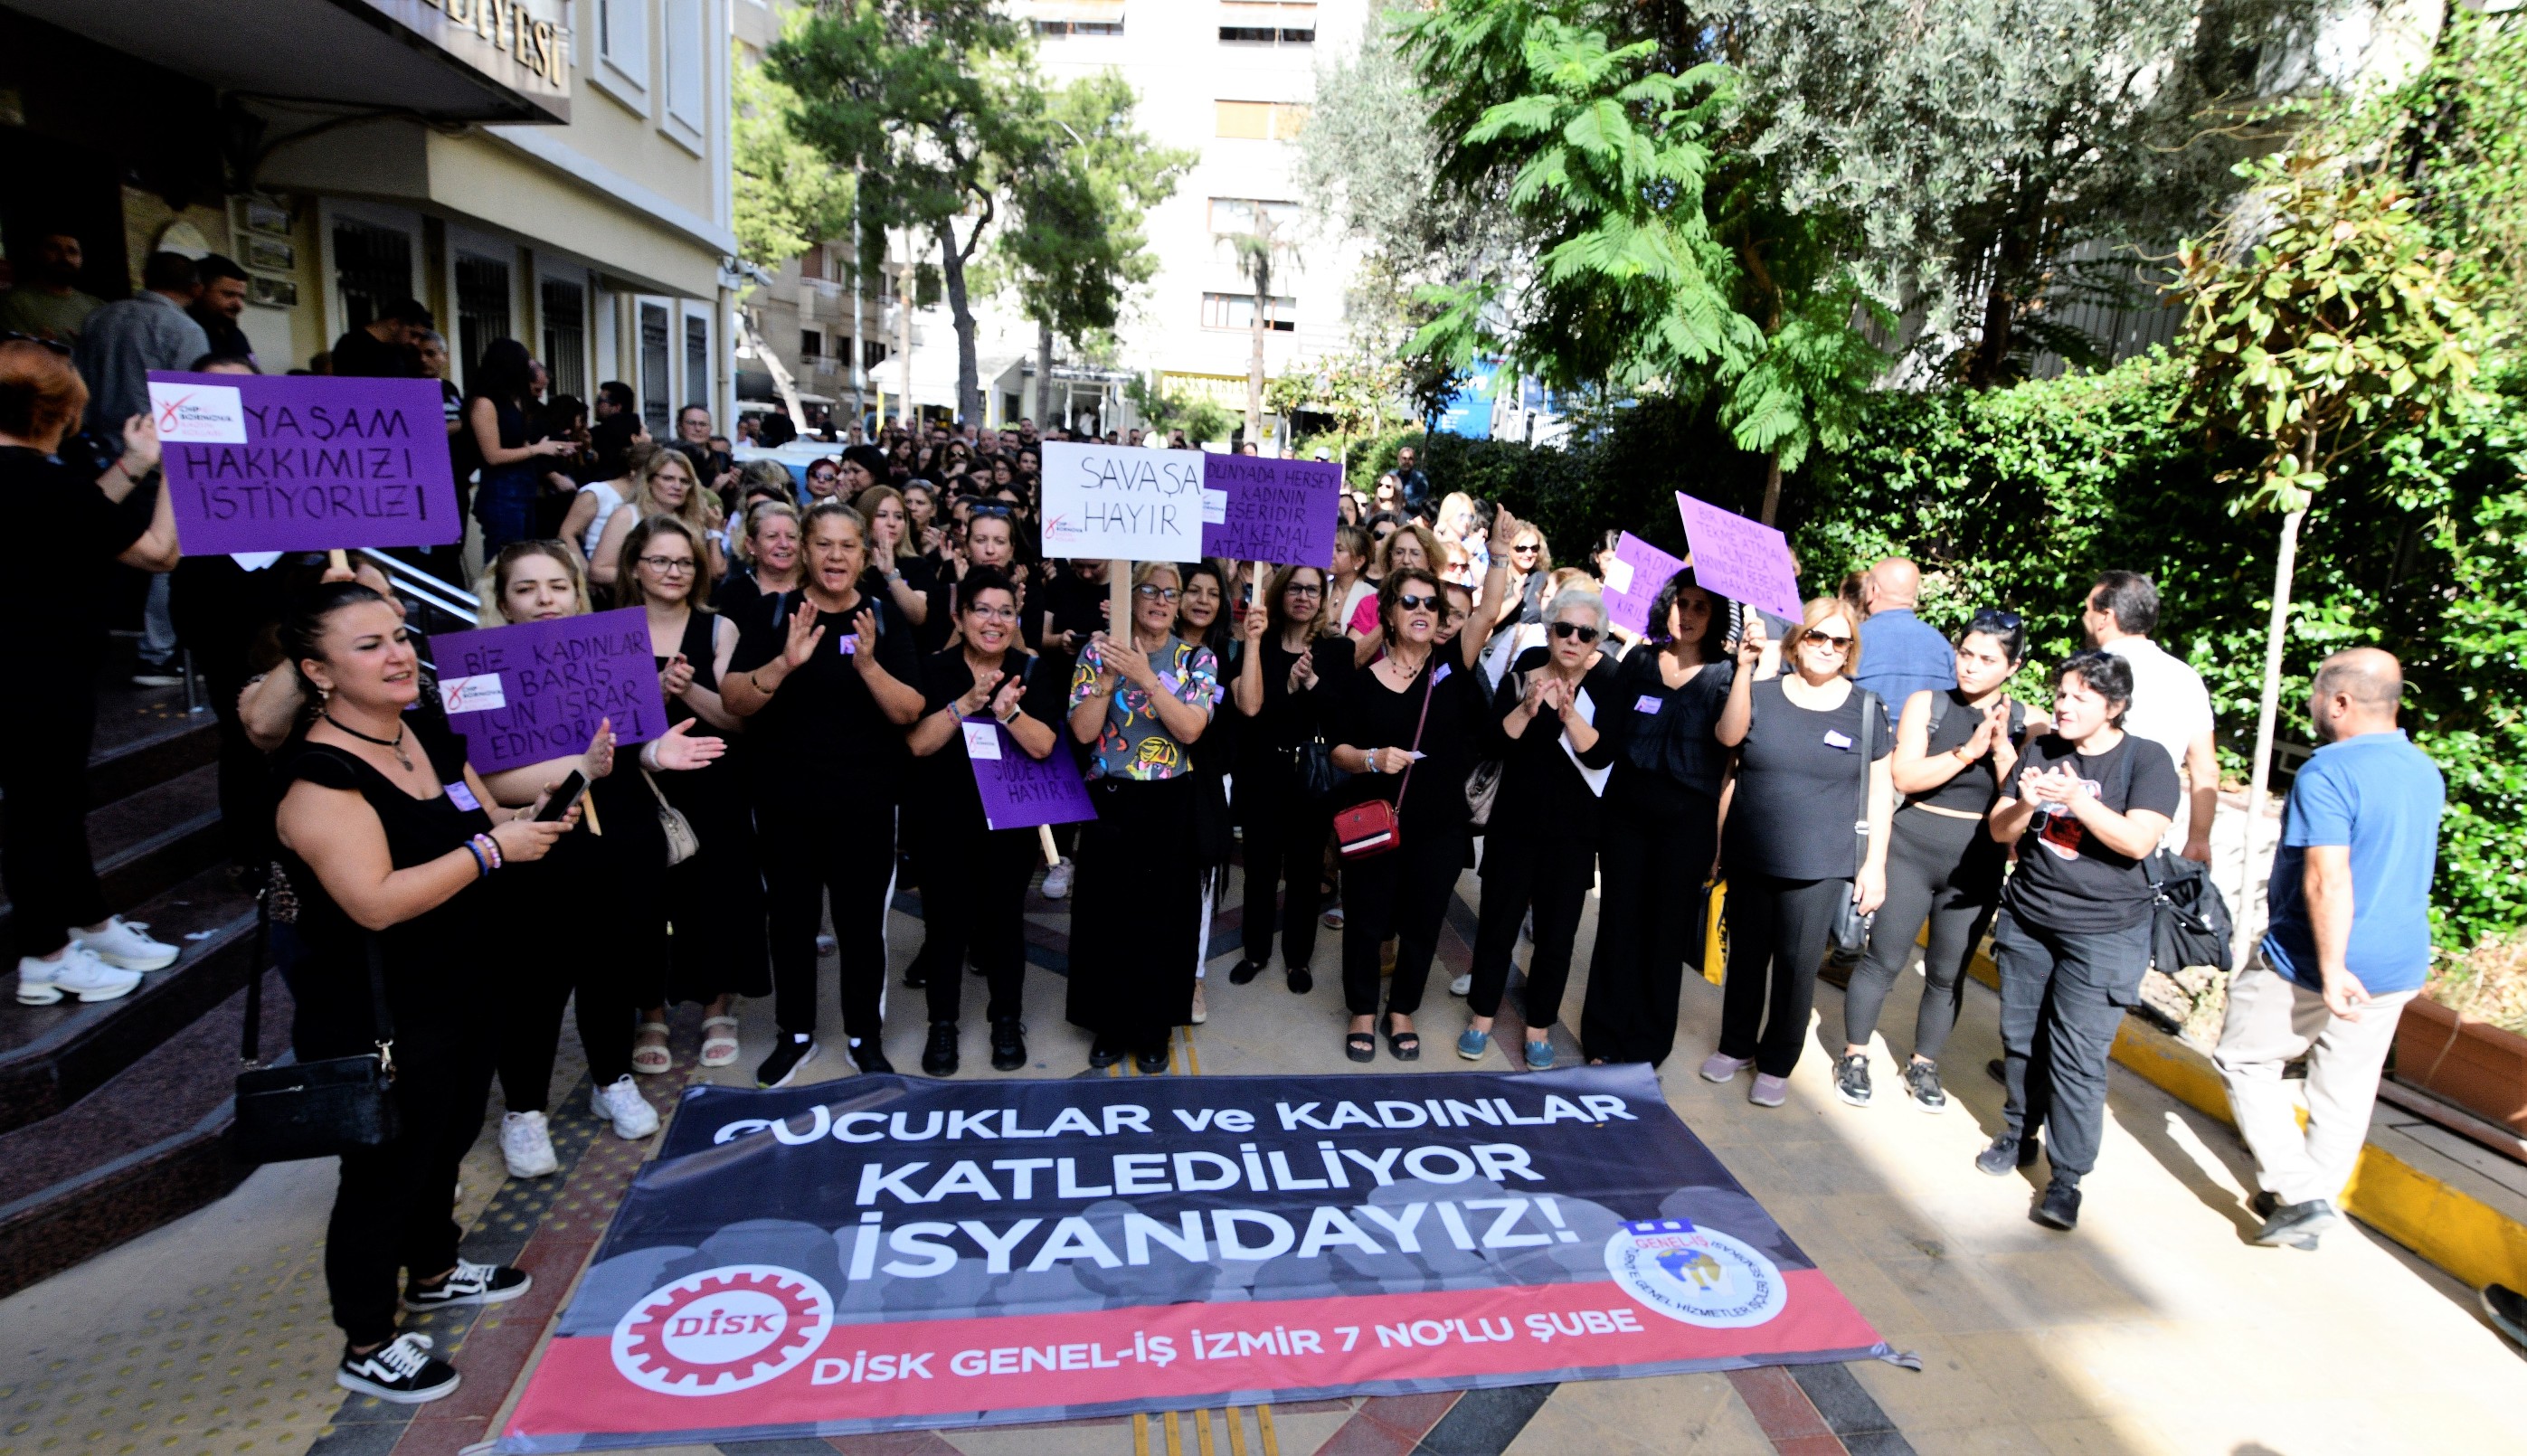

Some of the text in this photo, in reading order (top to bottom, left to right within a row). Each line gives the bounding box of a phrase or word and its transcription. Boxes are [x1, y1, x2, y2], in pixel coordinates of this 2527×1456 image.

[184, 446, 413, 479] HAKKIMIZI
[1080, 457, 1201, 497] SAVAŞA
[1241, 486, 1306, 506] KADININ
[1084, 501, 1182, 535] HAYIR
[1249, 524, 1314, 549] KEMAL
[464, 630, 648, 675] BİZ KADINLAR
[555, 679, 643, 720] ISRAR
[1172, 1108, 1256, 1133] ve
[1275, 1094, 1639, 1130] KADINLAR
[855, 1140, 1545, 1205] KATLEDİLİYOR
[847, 1196, 1581, 1281] İSYANDAYIZ!
[1635, 1280, 1672, 1307] GENEL
[1677, 1302, 1748, 1319] HİZMETLER
[670, 1309, 781, 1338] DİSK
[810, 1349, 935, 1385] DİSK
[950, 1328, 1177, 1376] GENEL-İŞ
[1192, 1325, 1323, 1360] İZMİR
[1334, 1327, 1359, 1352] 7
[1524, 1309, 1644, 1343] ŞUBE
